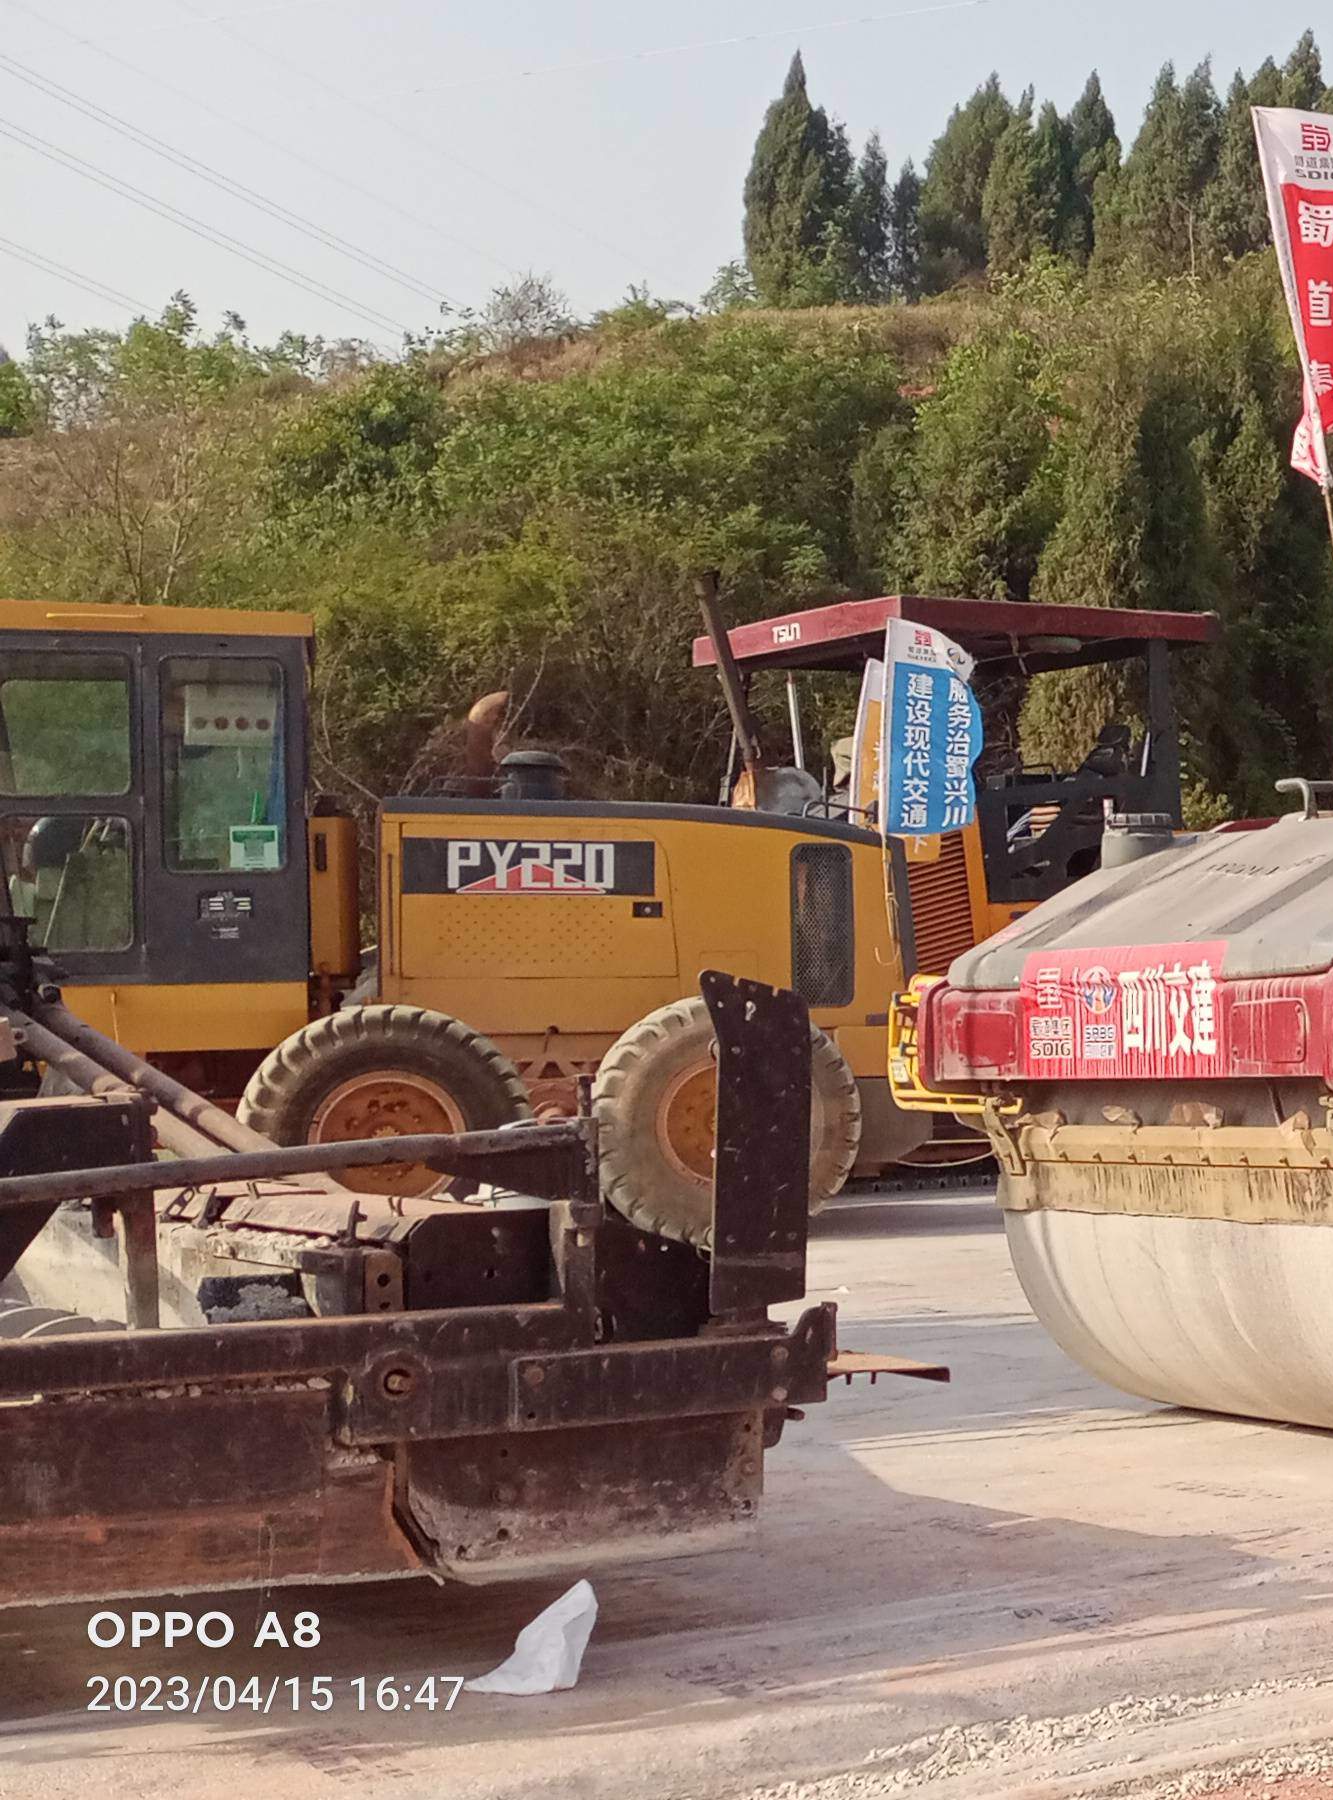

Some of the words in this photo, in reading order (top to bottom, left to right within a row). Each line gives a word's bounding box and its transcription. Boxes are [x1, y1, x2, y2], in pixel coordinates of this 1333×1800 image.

[900, 671, 935, 828] 建设现代交通
[447, 841, 615, 889] PY220
[1117, 959, 1216, 1056] 四川交建
[1031, 1040, 1071, 1057] SDIG
